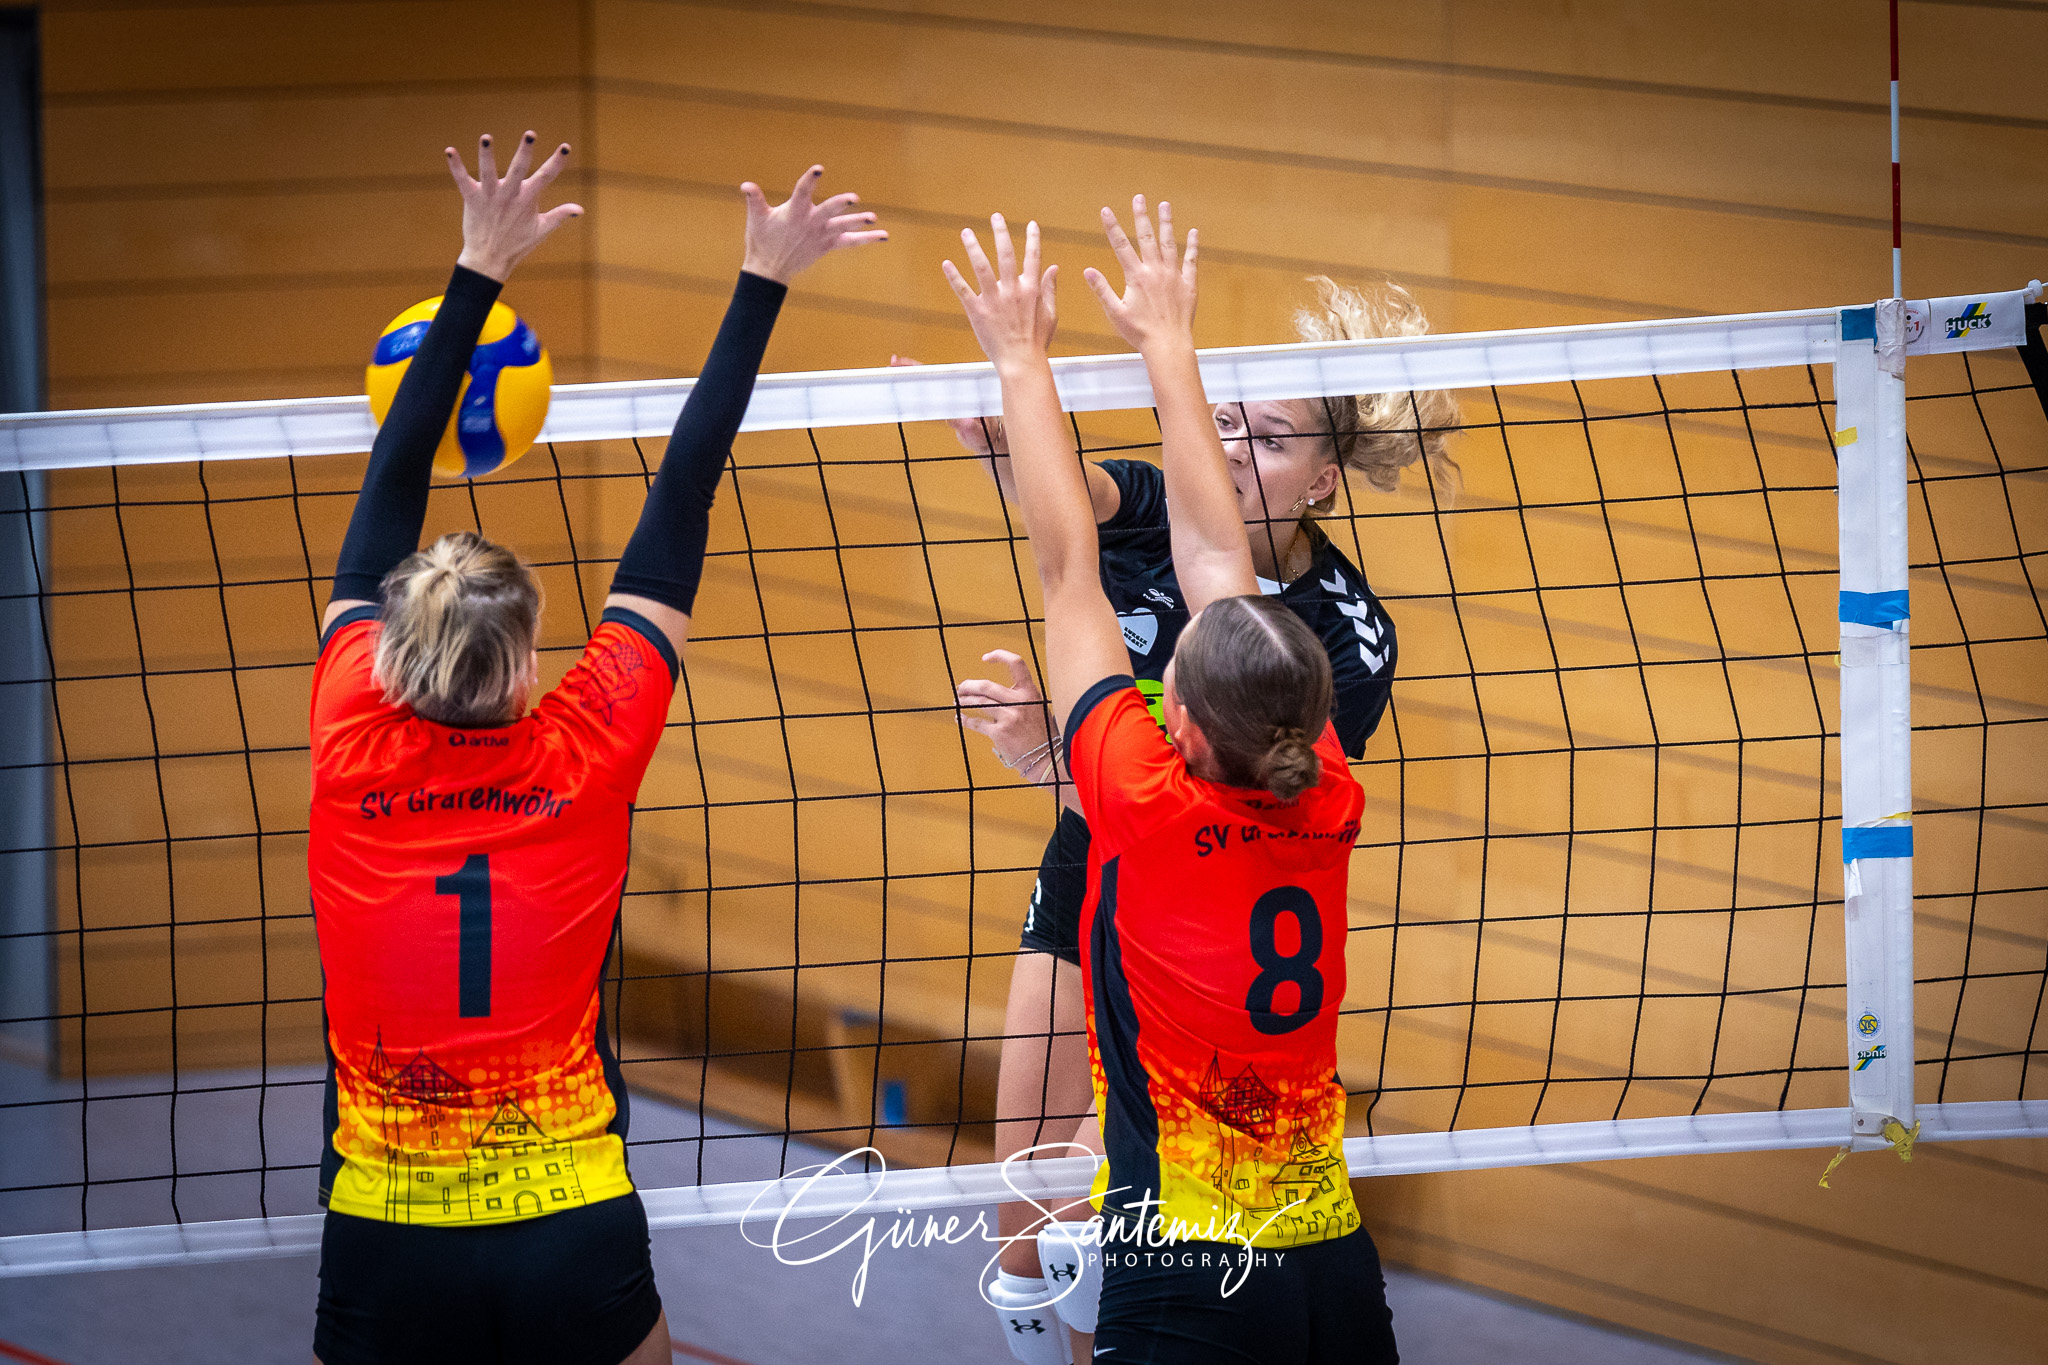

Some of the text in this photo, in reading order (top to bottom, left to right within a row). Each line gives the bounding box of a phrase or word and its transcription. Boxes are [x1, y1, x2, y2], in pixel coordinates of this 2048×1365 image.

[1945, 314, 1991, 332] HUCK
[360, 791, 400, 820] SV
[1195, 824, 1232, 857] SV
[435, 853, 492, 1018] 1
[1245, 885, 1324, 1036] 8
